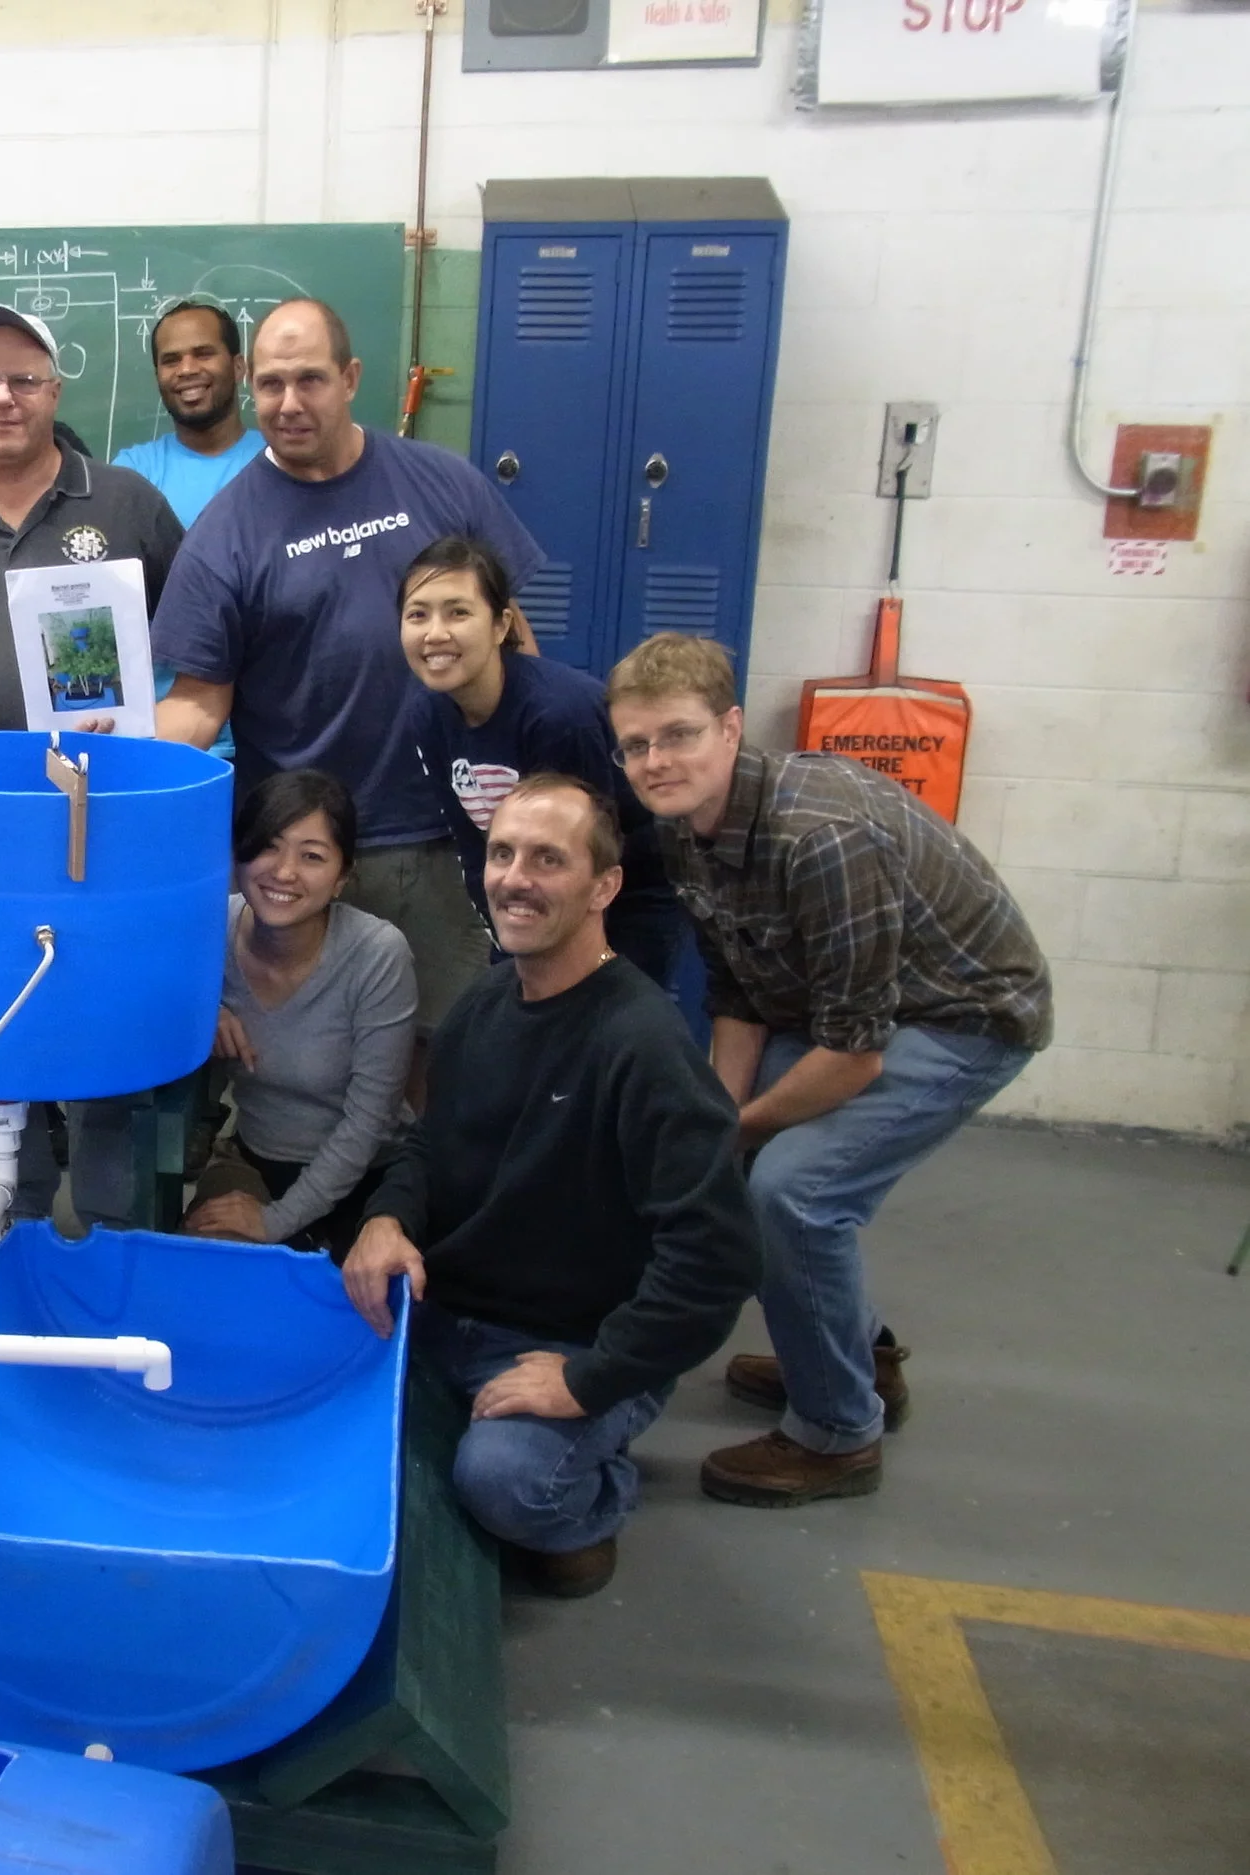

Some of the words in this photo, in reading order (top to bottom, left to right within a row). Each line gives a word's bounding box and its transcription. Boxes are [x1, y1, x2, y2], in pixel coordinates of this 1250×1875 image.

[286, 532, 326, 558] new
[327, 512, 410, 545] balance
[820, 735, 946, 752] EMERGENCY
[860, 757, 903, 773] FIRE
